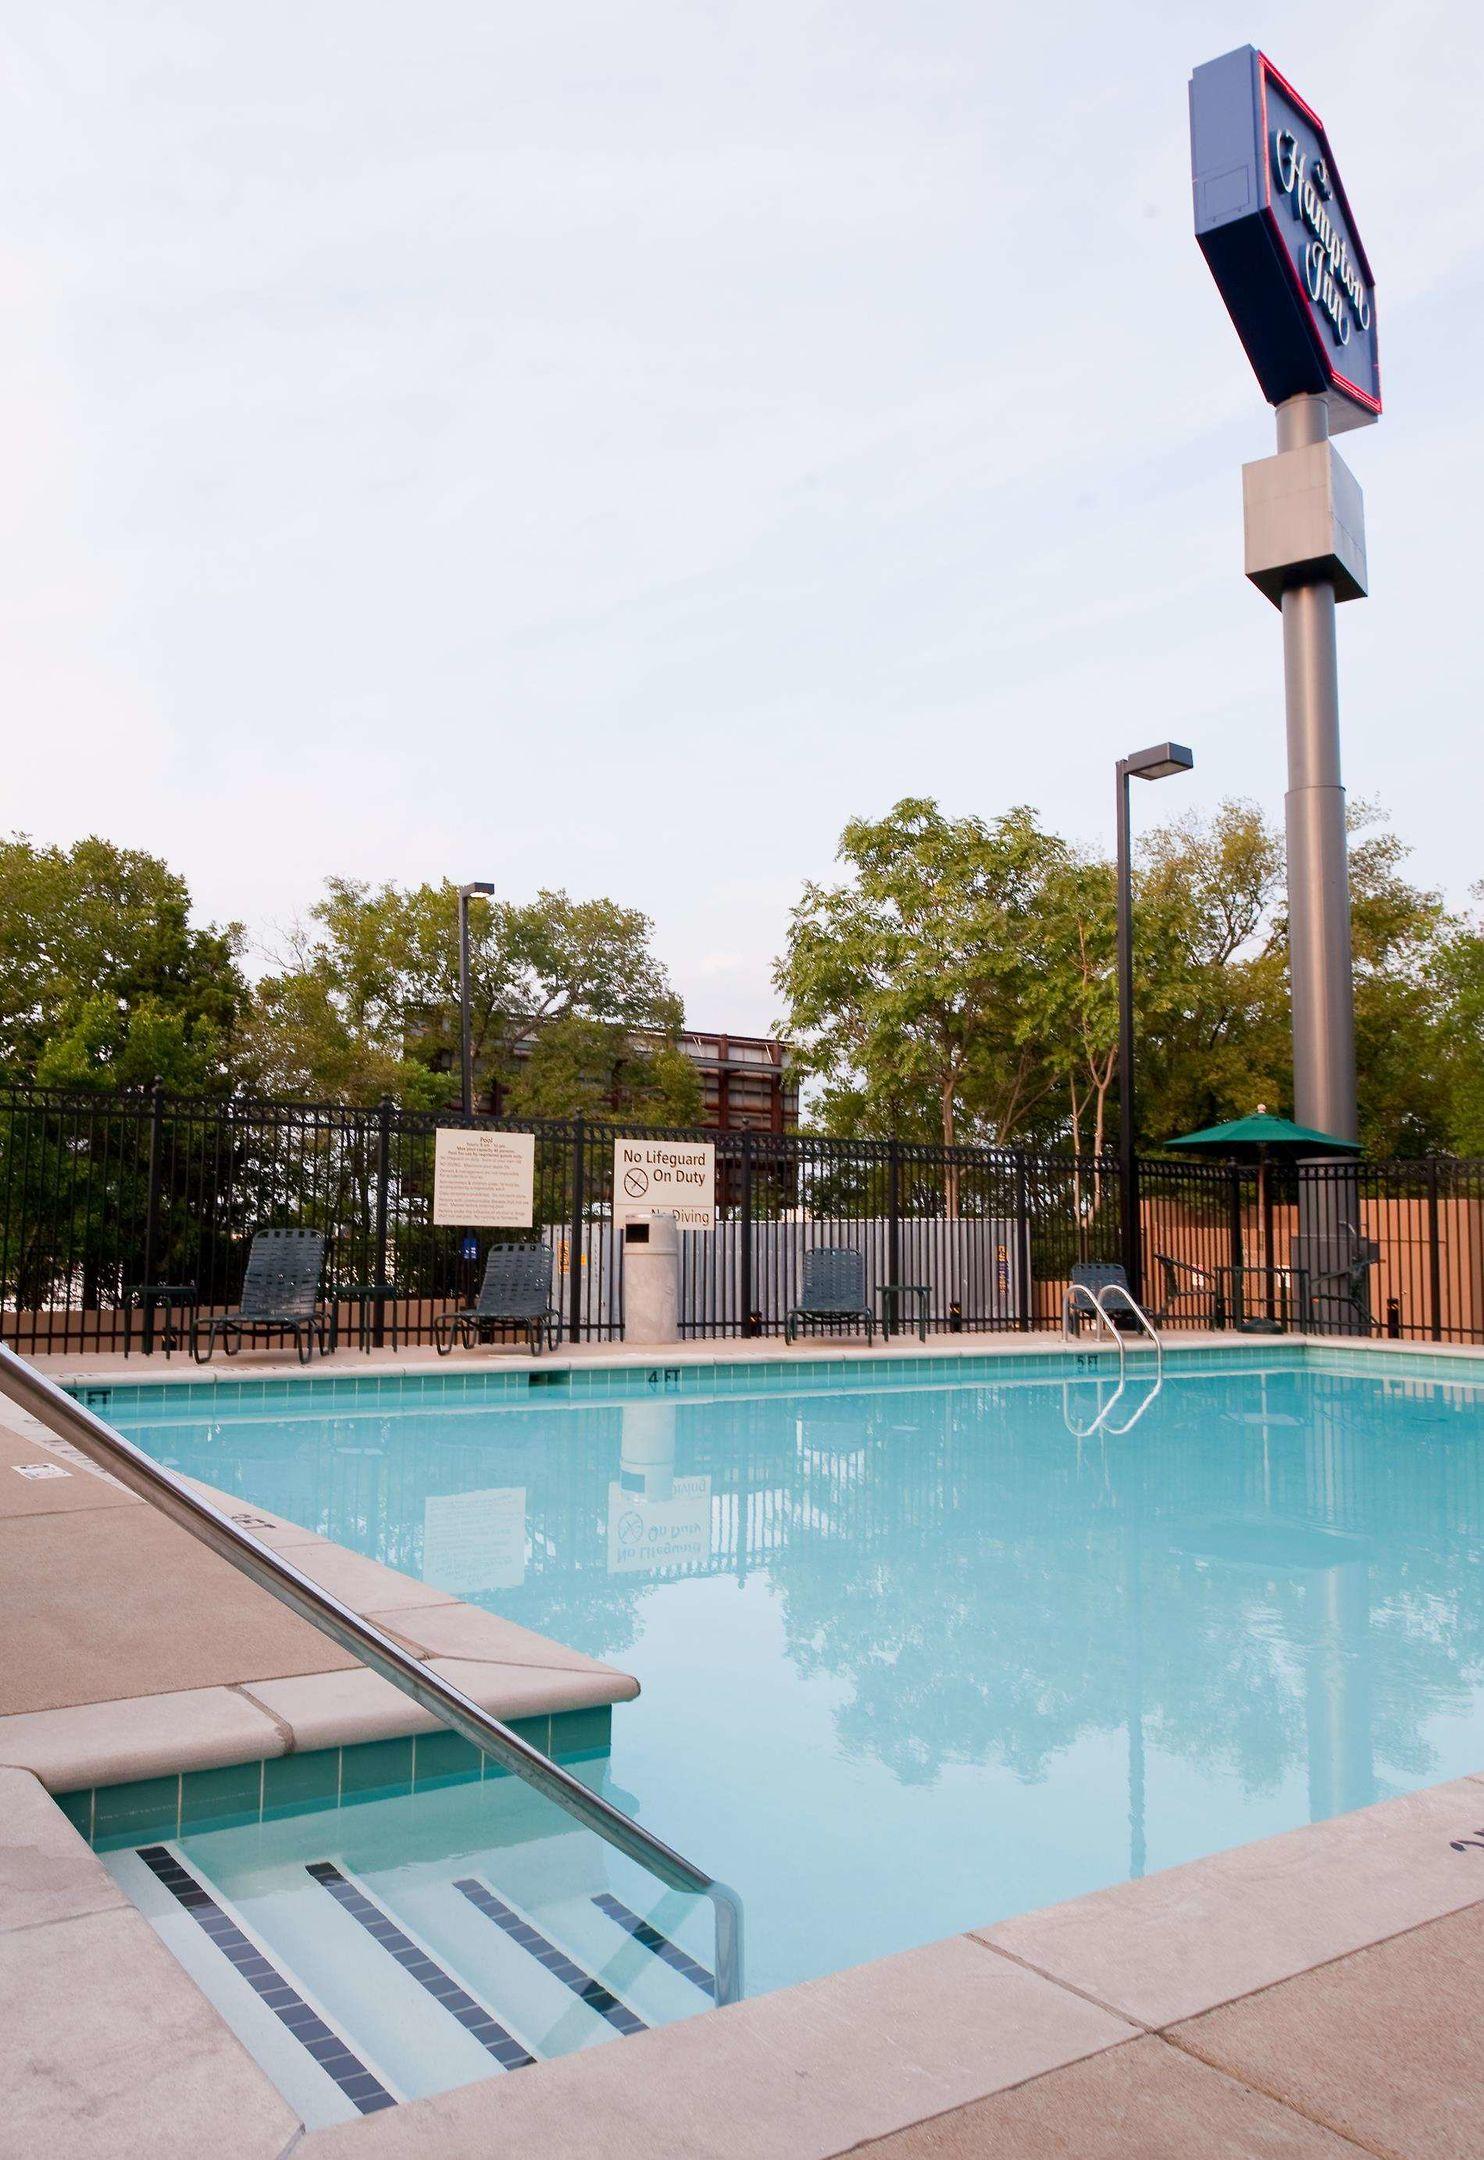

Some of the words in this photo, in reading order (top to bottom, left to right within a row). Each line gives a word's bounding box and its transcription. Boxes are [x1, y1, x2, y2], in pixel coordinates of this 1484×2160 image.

[1274, 127, 1370, 331] Hampton
[1304, 241, 1351, 346] Inn
[623, 1149, 642, 1163] No
[646, 1150, 706, 1168] Lifeguard
[653, 1168, 672, 1182] On
[676, 1169, 706, 1187] Duty
[672, 1208, 710, 1226] Diving
[648, 1370, 659, 1383] 4
[664, 1369, 681, 1383] FT
